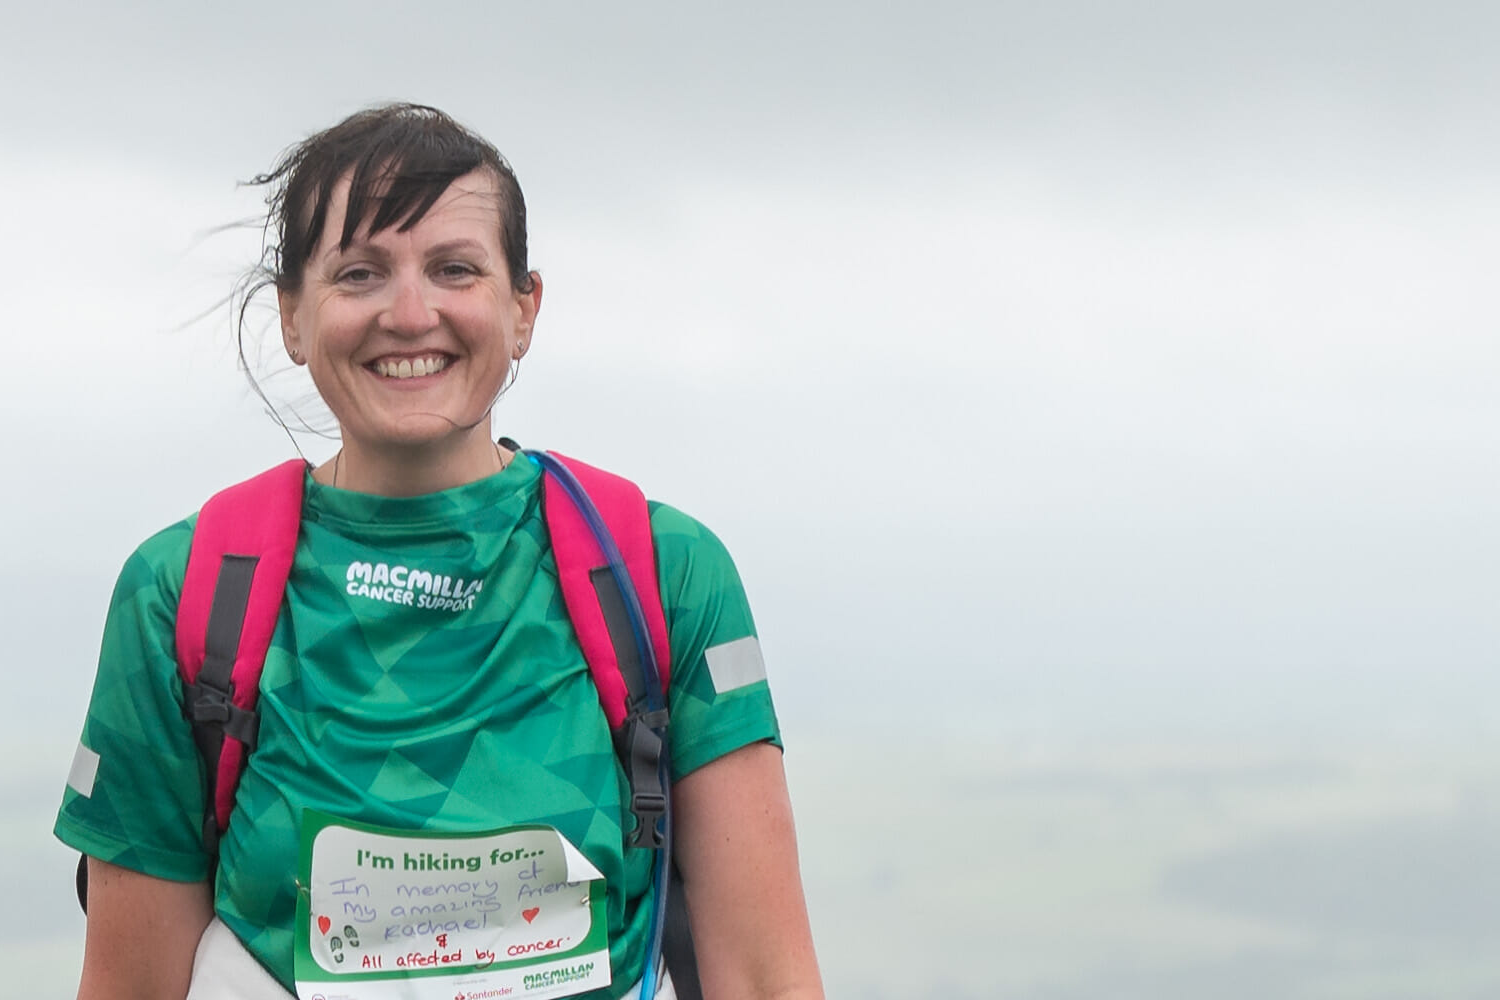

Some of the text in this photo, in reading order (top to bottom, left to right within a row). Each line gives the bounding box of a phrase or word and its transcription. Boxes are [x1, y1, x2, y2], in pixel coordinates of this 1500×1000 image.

[346, 581, 415, 606] CANCER
[357, 847, 544, 872] I'm hiking for...
[329, 877, 370, 897] In
[396, 880, 499, 898] memory
[390, 896, 501, 917] amazing
[362, 954, 382, 969] All
[396, 949, 462, 967] affected
[475, 948, 495, 970] by
[523, 961, 594, 985] MACMILLAN
[466, 987, 514, 1000] Santander
